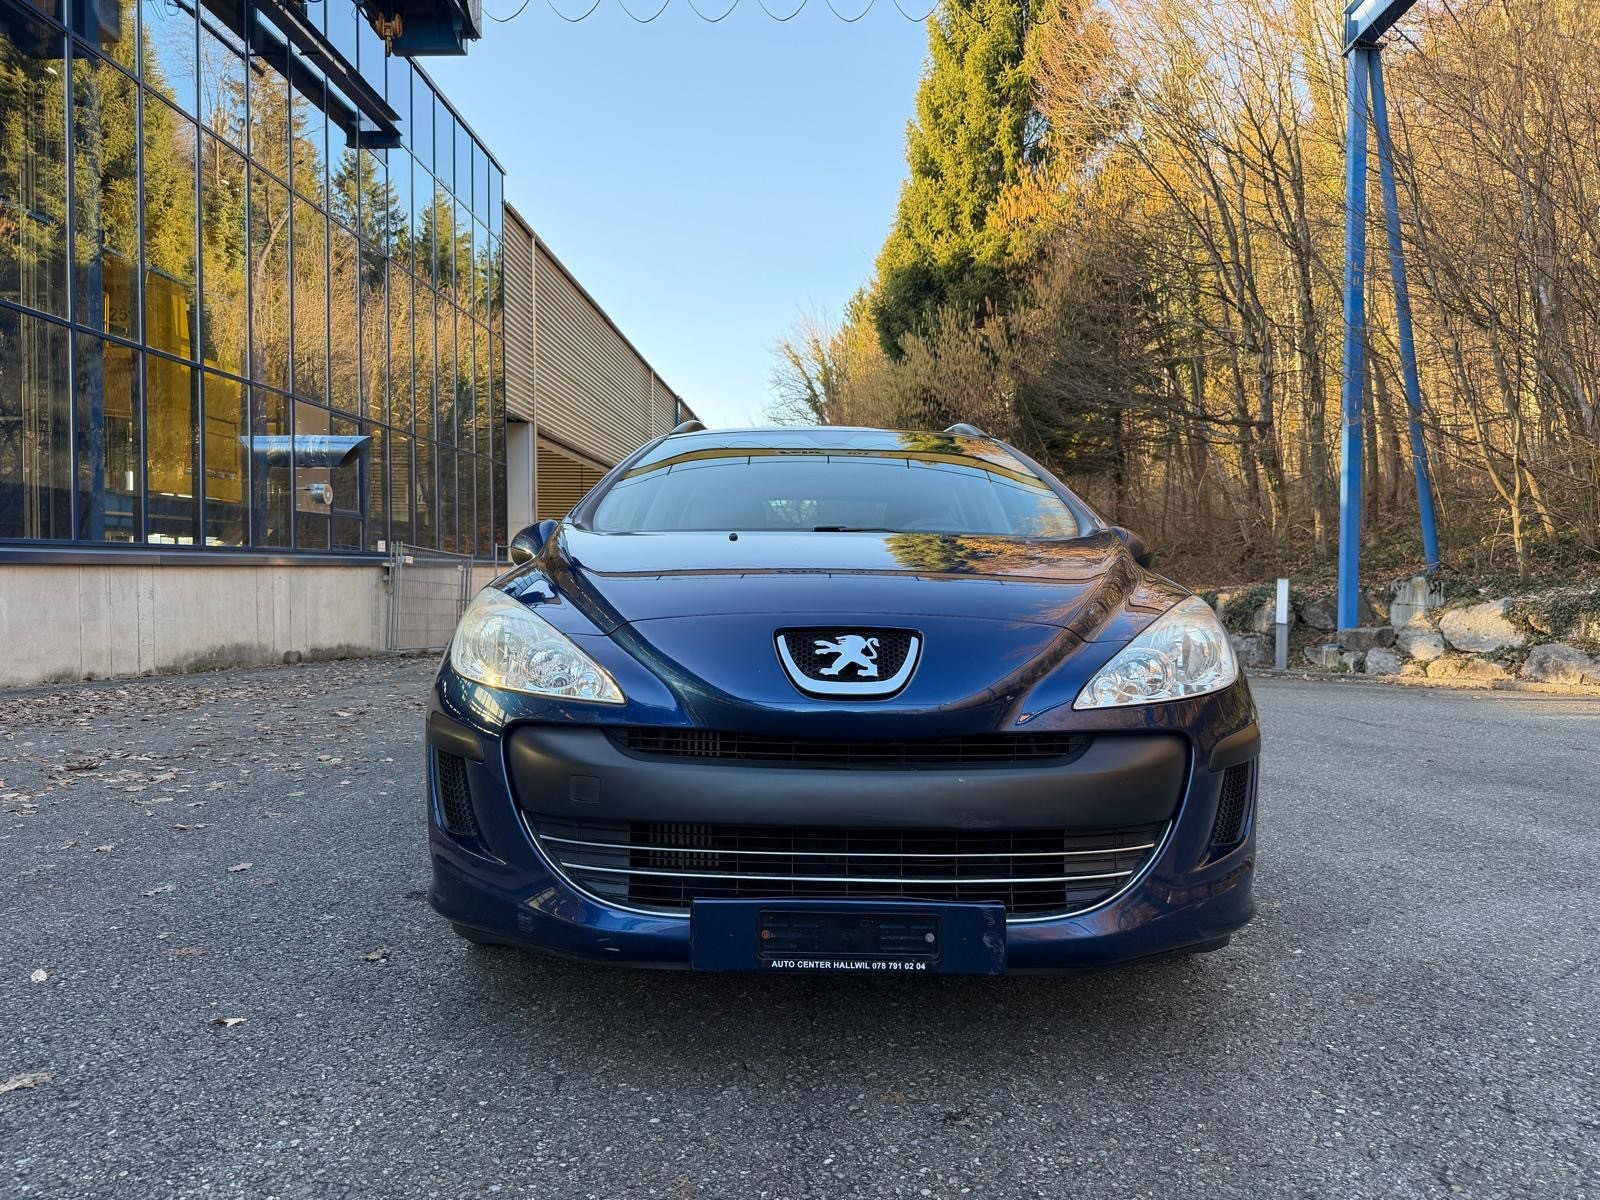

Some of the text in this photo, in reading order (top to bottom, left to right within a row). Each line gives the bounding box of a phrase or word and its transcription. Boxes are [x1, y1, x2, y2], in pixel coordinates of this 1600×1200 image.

[771, 960, 926, 971] AUTO CENTER HALLWIL 078 791 02 04
